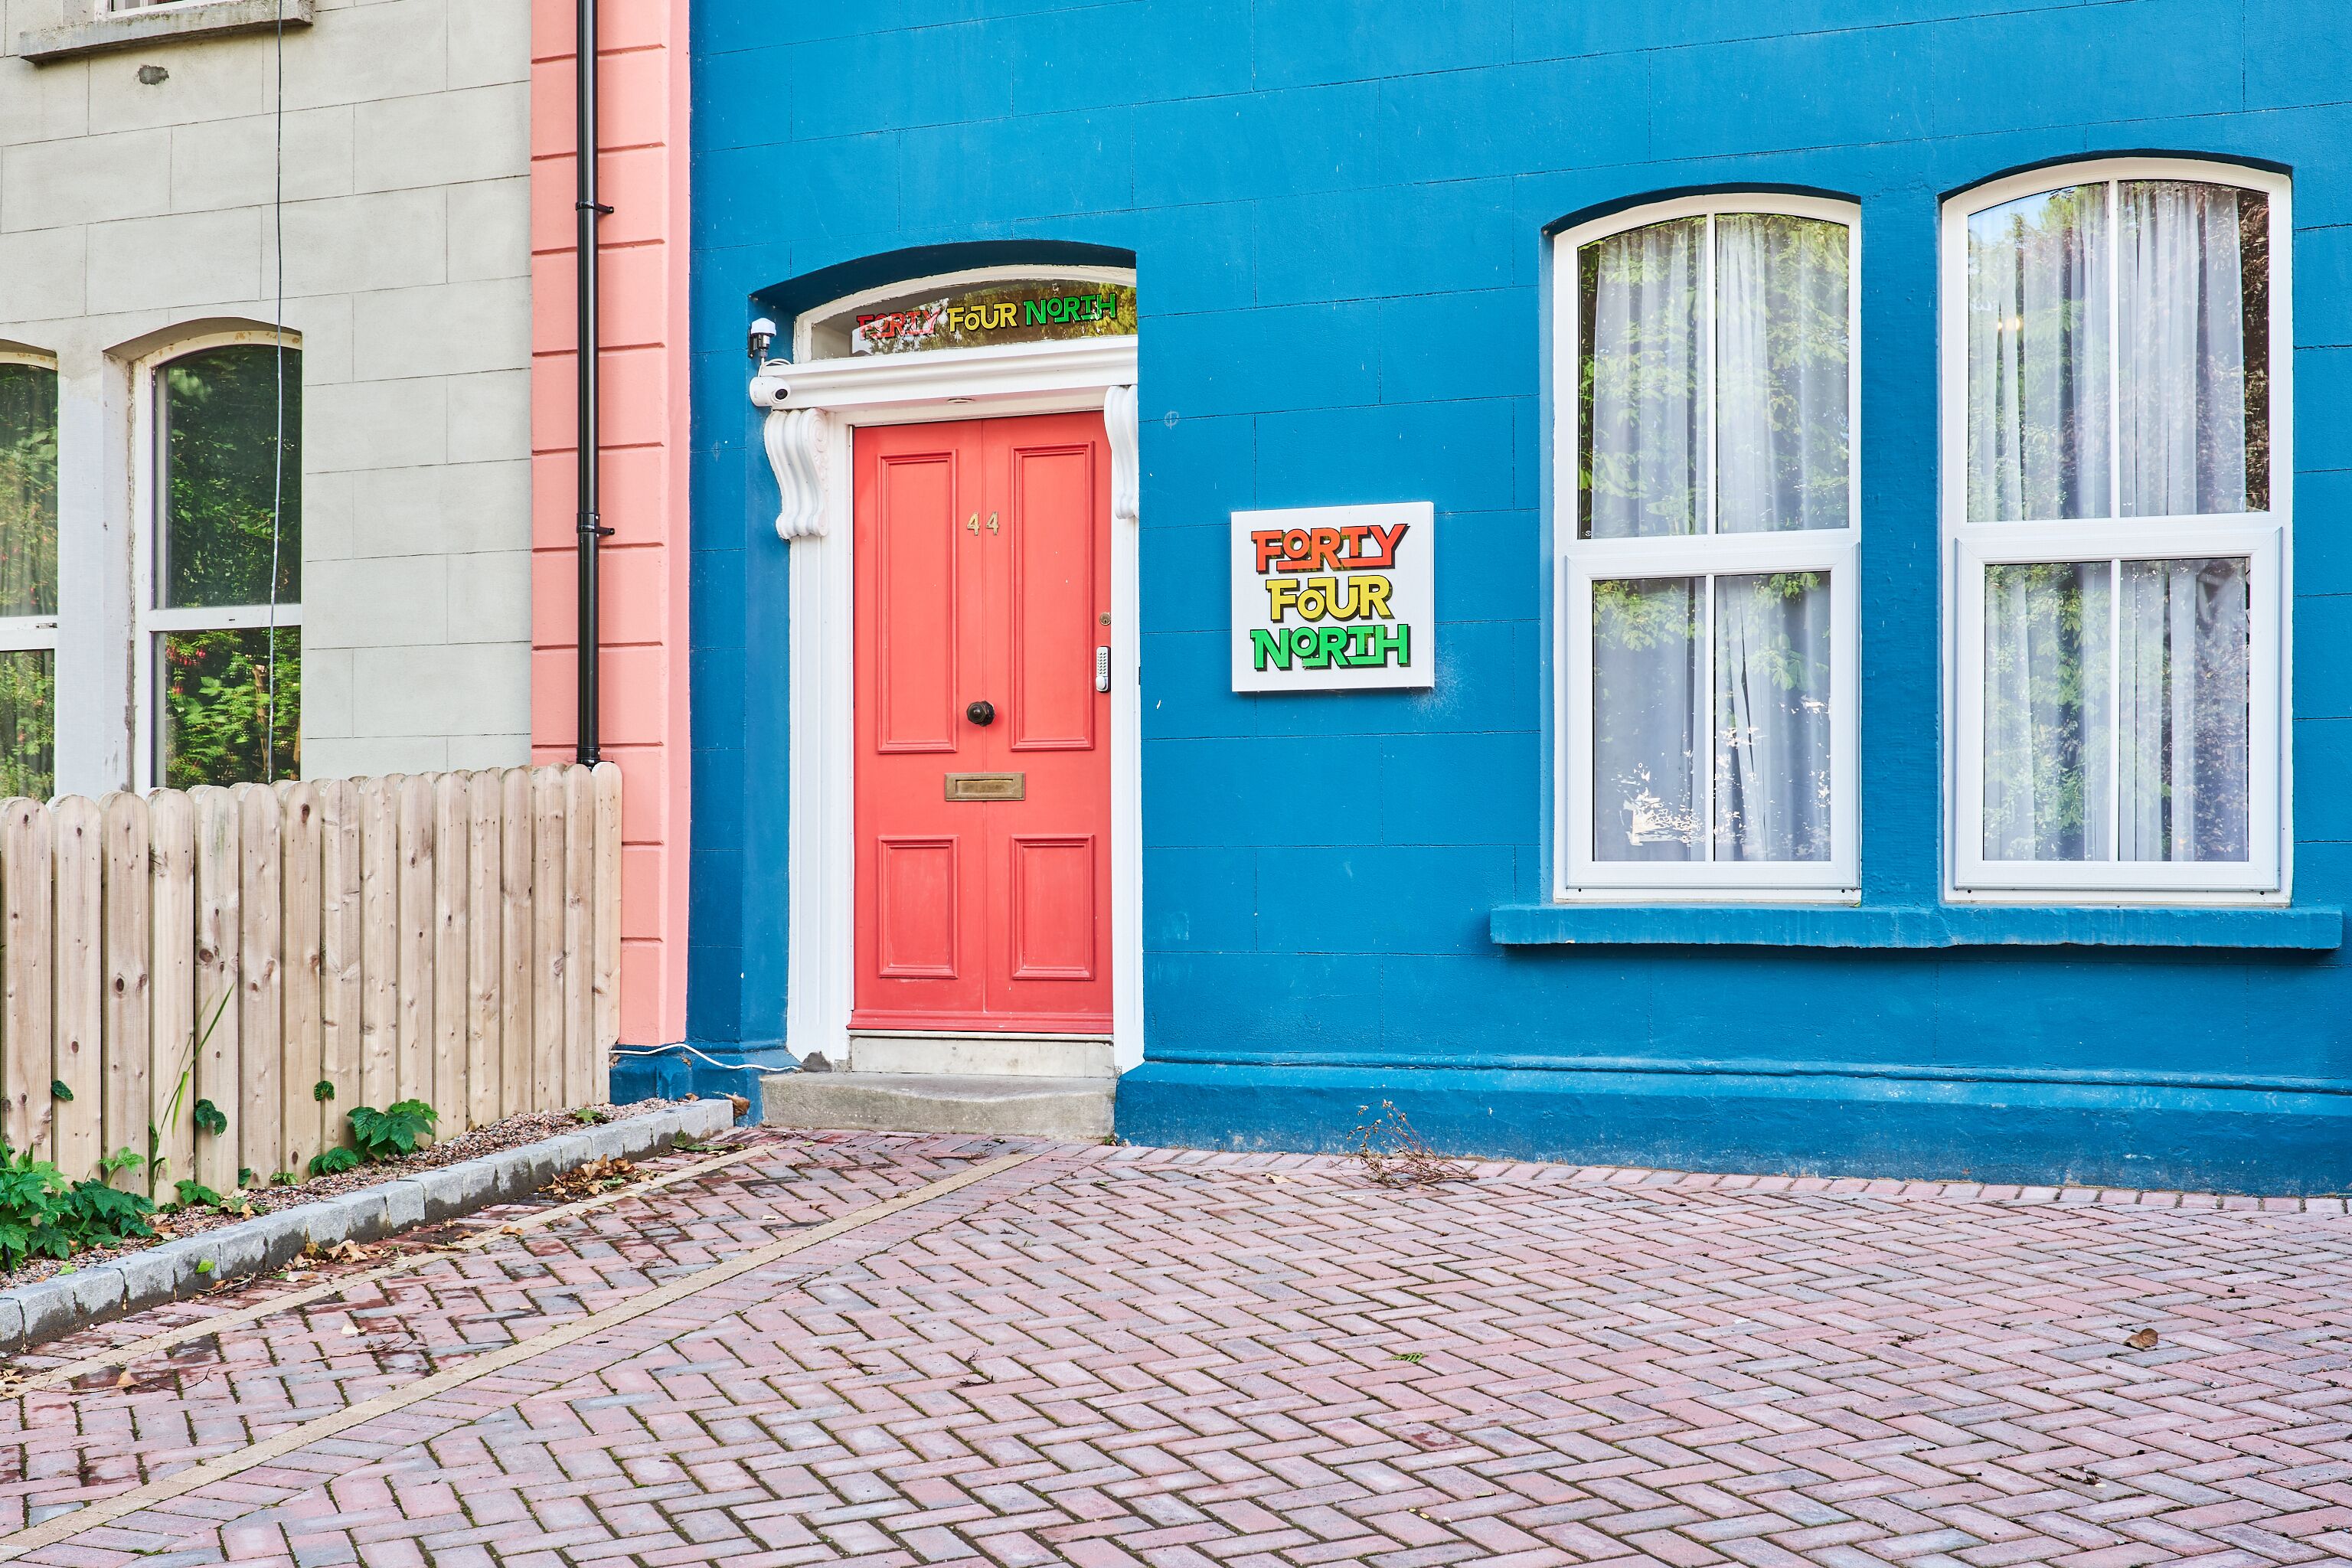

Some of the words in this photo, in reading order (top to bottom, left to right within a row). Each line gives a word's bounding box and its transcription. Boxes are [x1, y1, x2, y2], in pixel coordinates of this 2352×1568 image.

[856, 309, 942, 341] FORTY
[946, 302, 1018, 333] FOUR
[1023, 292, 1117, 326] NORTH
[966, 511, 999, 537] 44
[1251, 523, 1410, 574] FORTY
[1266, 574, 1395, 623] FOUR
[1250, 623, 1411, 671] NORTH
